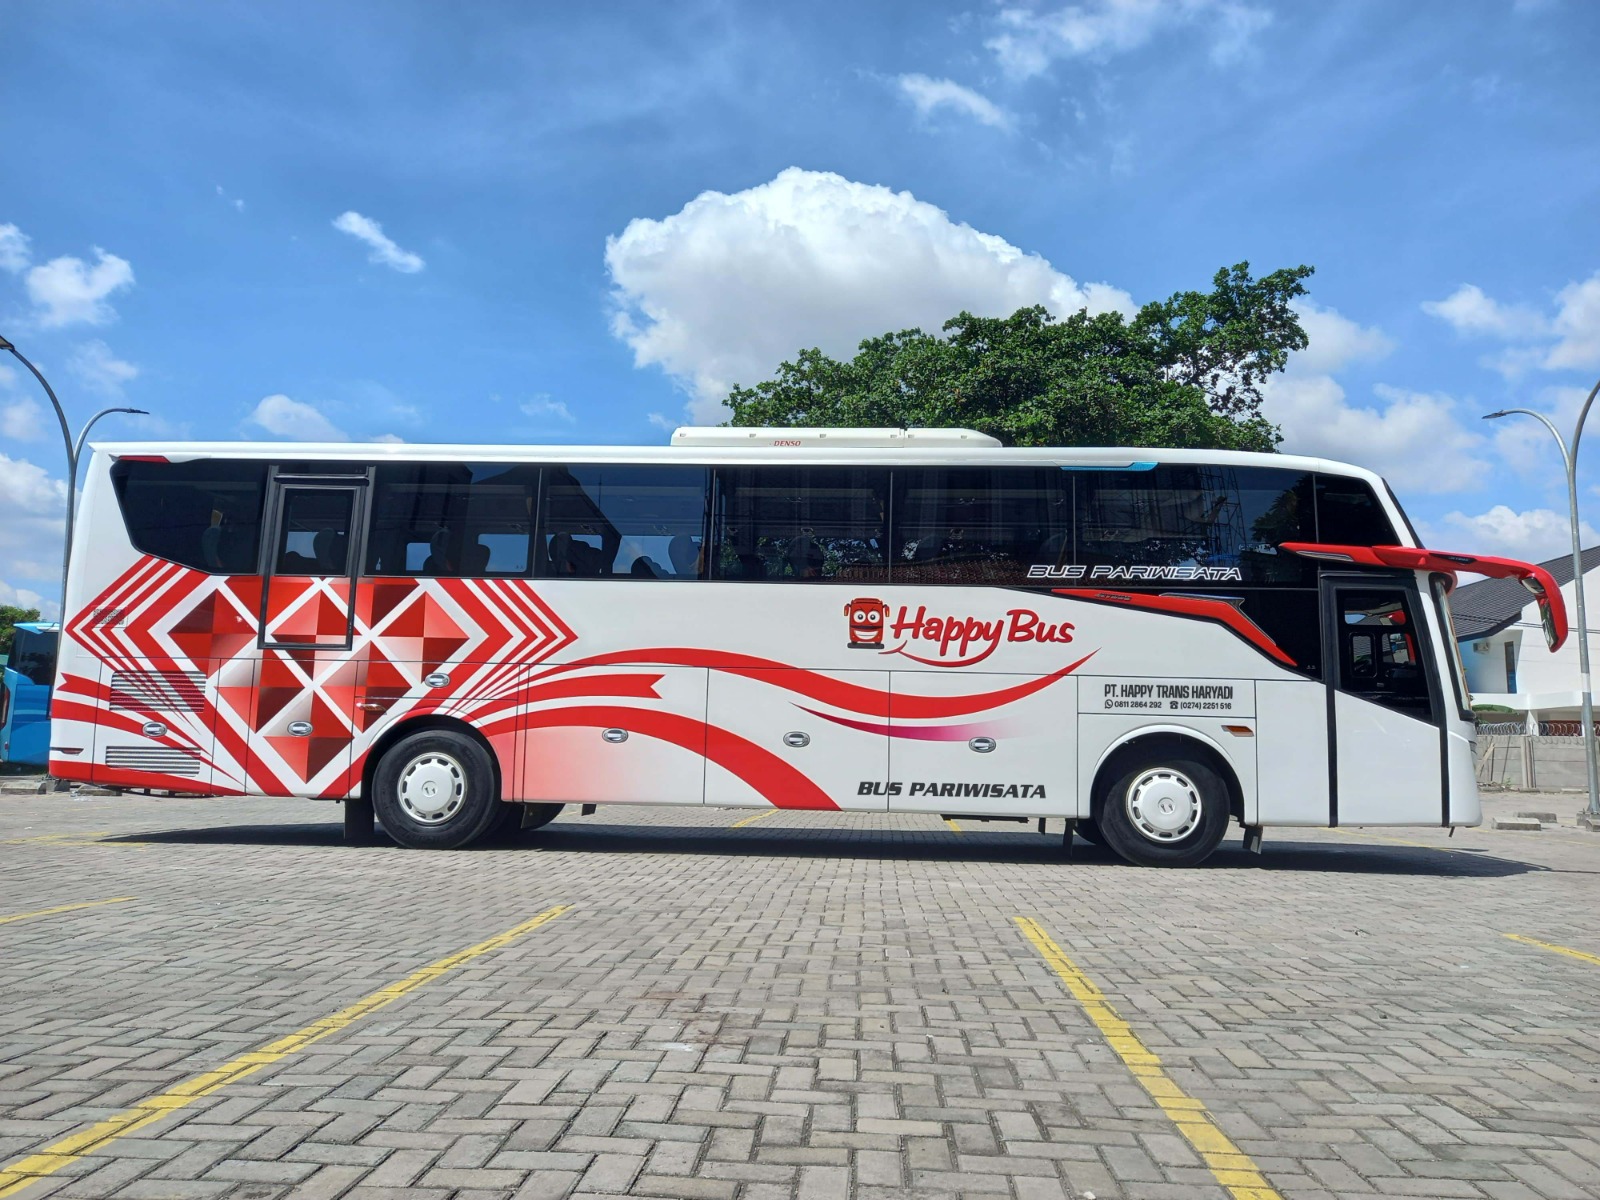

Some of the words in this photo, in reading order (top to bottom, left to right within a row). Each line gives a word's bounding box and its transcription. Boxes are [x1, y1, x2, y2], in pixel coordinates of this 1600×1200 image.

[1027, 565, 1087, 579] BUS
[1090, 565, 1242, 580] PARIWISATA
[889, 606, 1004, 667] Happy
[1006, 609, 1075, 643] Bus
[1104, 684, 1119, 698] PT.
[1120, 684, 1154, 698] HAPPY
[1156, 685, 1190, 699] TRANS
[1191, 686, 1233, 699] HARYADI
[1114, 700, 1129, 708] 0811
[1148, 701, 1162, 709] 292
[1180, 701, 1202, 710] (0274)
[1202, 702, 1219, 710] 2251
[1220, 702, 1232, 710] 516
[857, 781, 903, 796] BUS
[908, 782, 1047, 799] PARIWISATA
